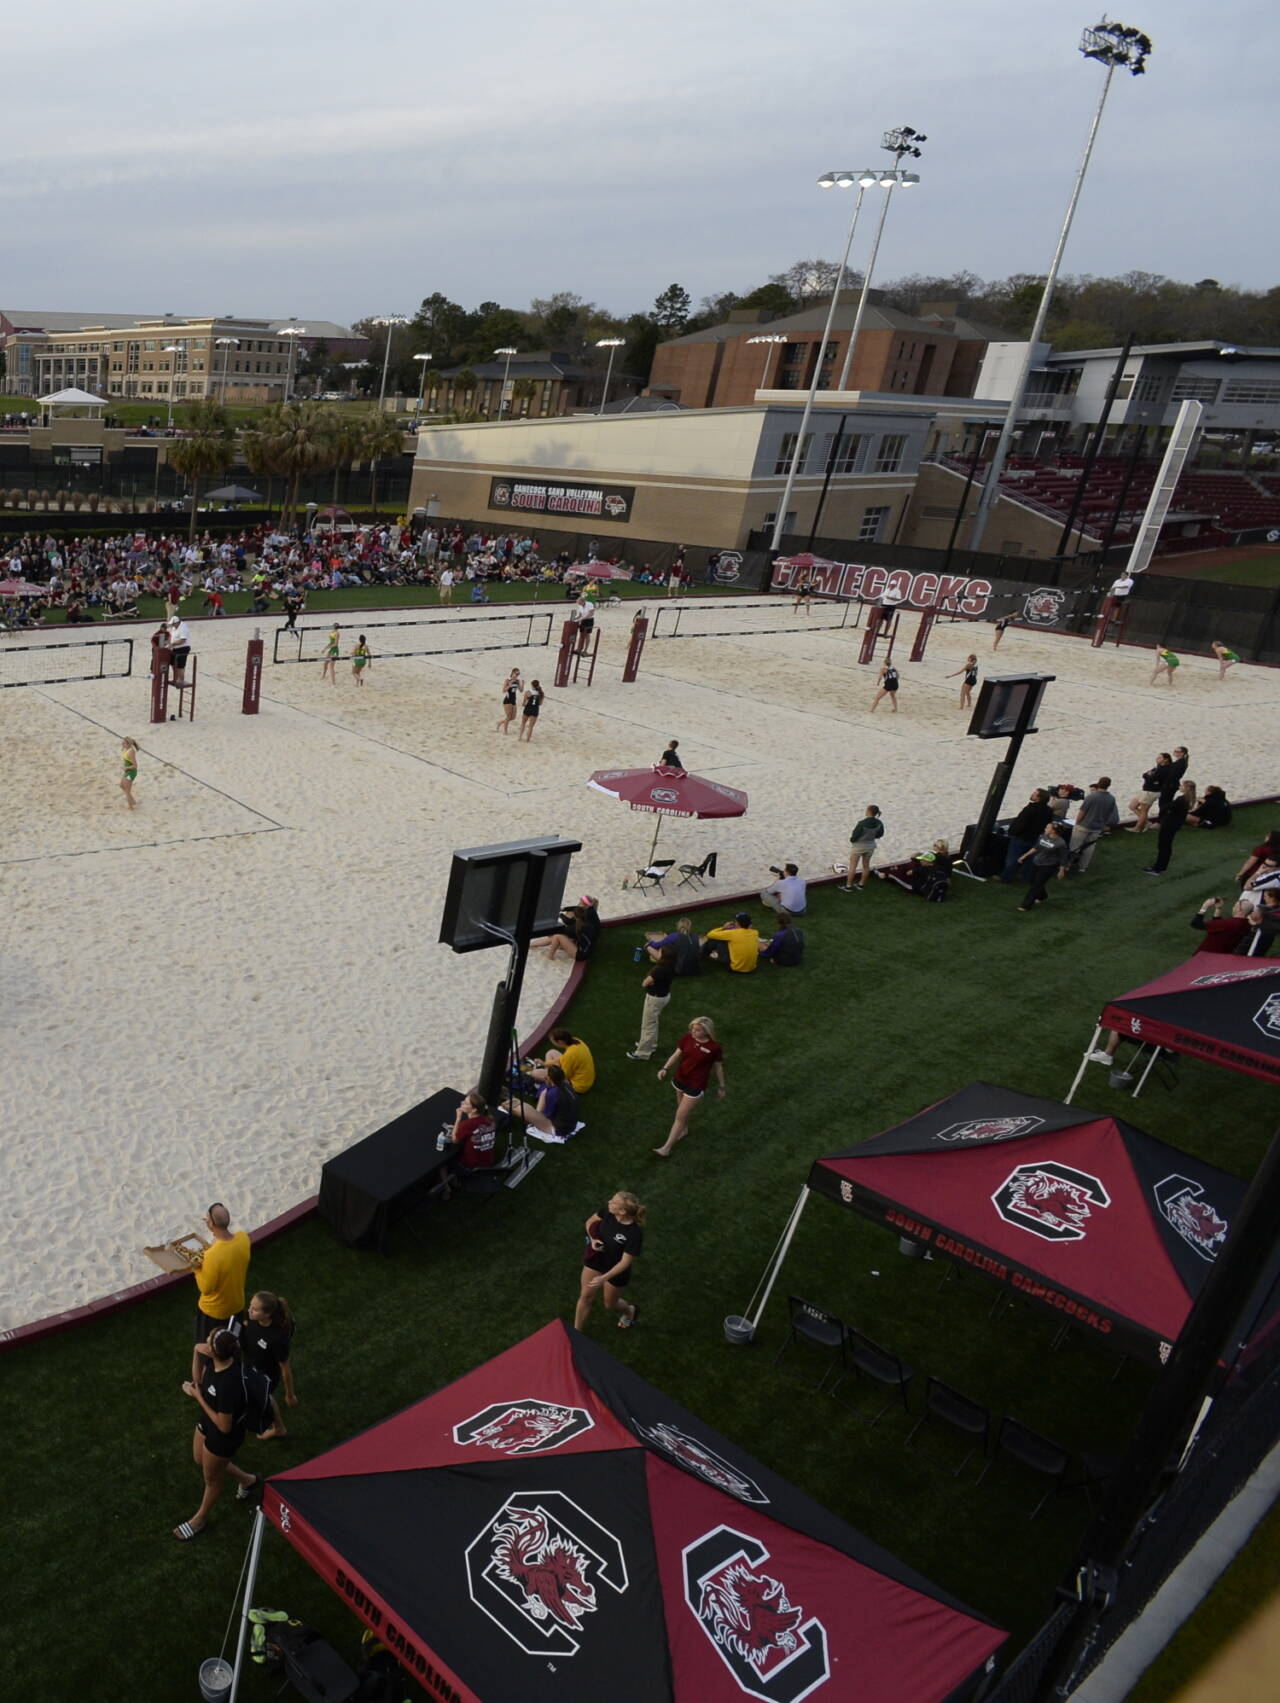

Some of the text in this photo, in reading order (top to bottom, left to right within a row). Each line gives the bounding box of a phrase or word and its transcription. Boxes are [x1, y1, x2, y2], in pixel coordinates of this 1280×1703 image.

[513, 484, 603, 500] GAMECOCK SAND VOLLEYBALL
[511, 493, 602, 514] SOUTH CAROLINA
[632, 804, 691, 818] SOUTH CAROLINA
[1174, 1033, 1215, 1054] SOUTH
[886, 1208, 1112, 1334] SOUTH CAROLINA GAMECOCKS
[336, 1568, 383, 1627] SOUTH
